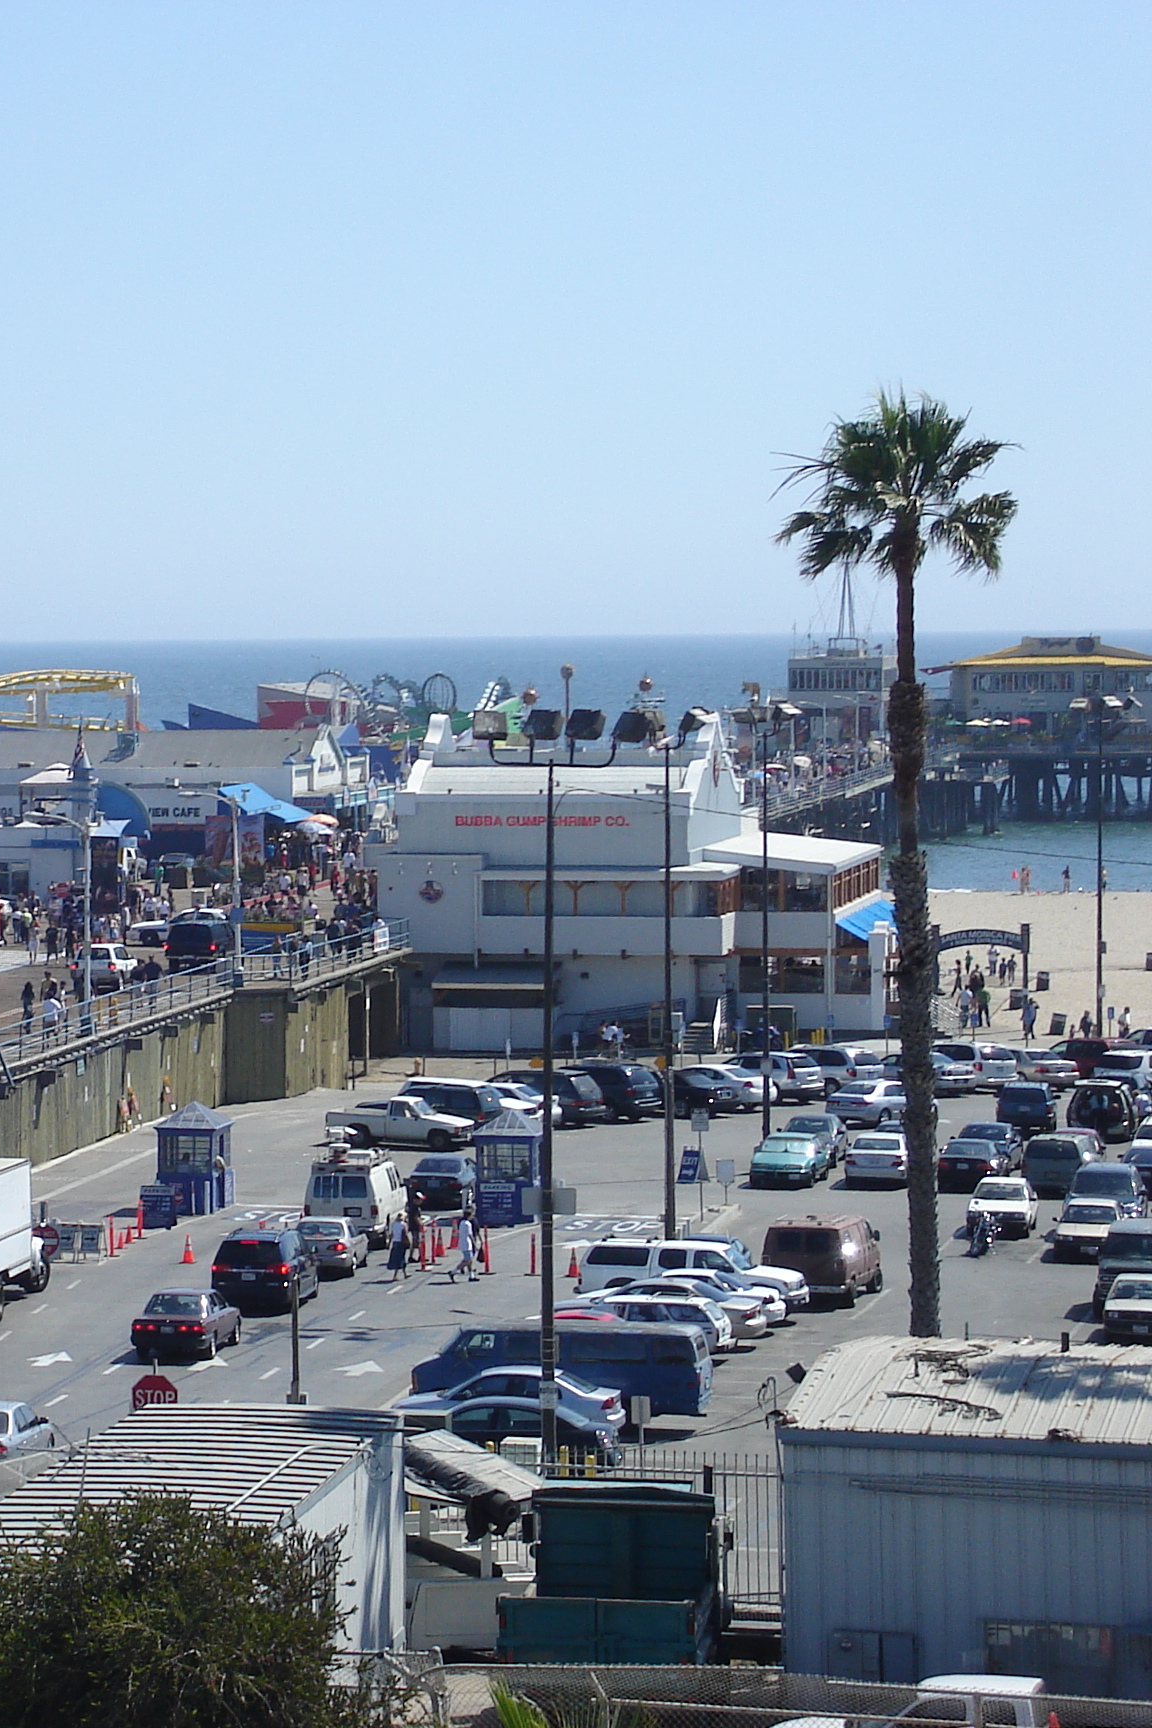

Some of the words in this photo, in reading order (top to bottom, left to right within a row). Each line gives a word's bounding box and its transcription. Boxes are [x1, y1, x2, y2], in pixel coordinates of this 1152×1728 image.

[172, 807, 200, 818] CAFE
[454, 815, 502, 827] BUBBA
[506, 815, 546, 827] GUMP
[551, 815, 601, 827] SHRIMP
[604, 815, 630, 827] CO.
[682, 1156, 698, 1165] EXIT
[234, 1210, 306, 1222] STO
[564, 1219, 663, 1233] STOP
[135, 1389, 176, 1407] STOP
